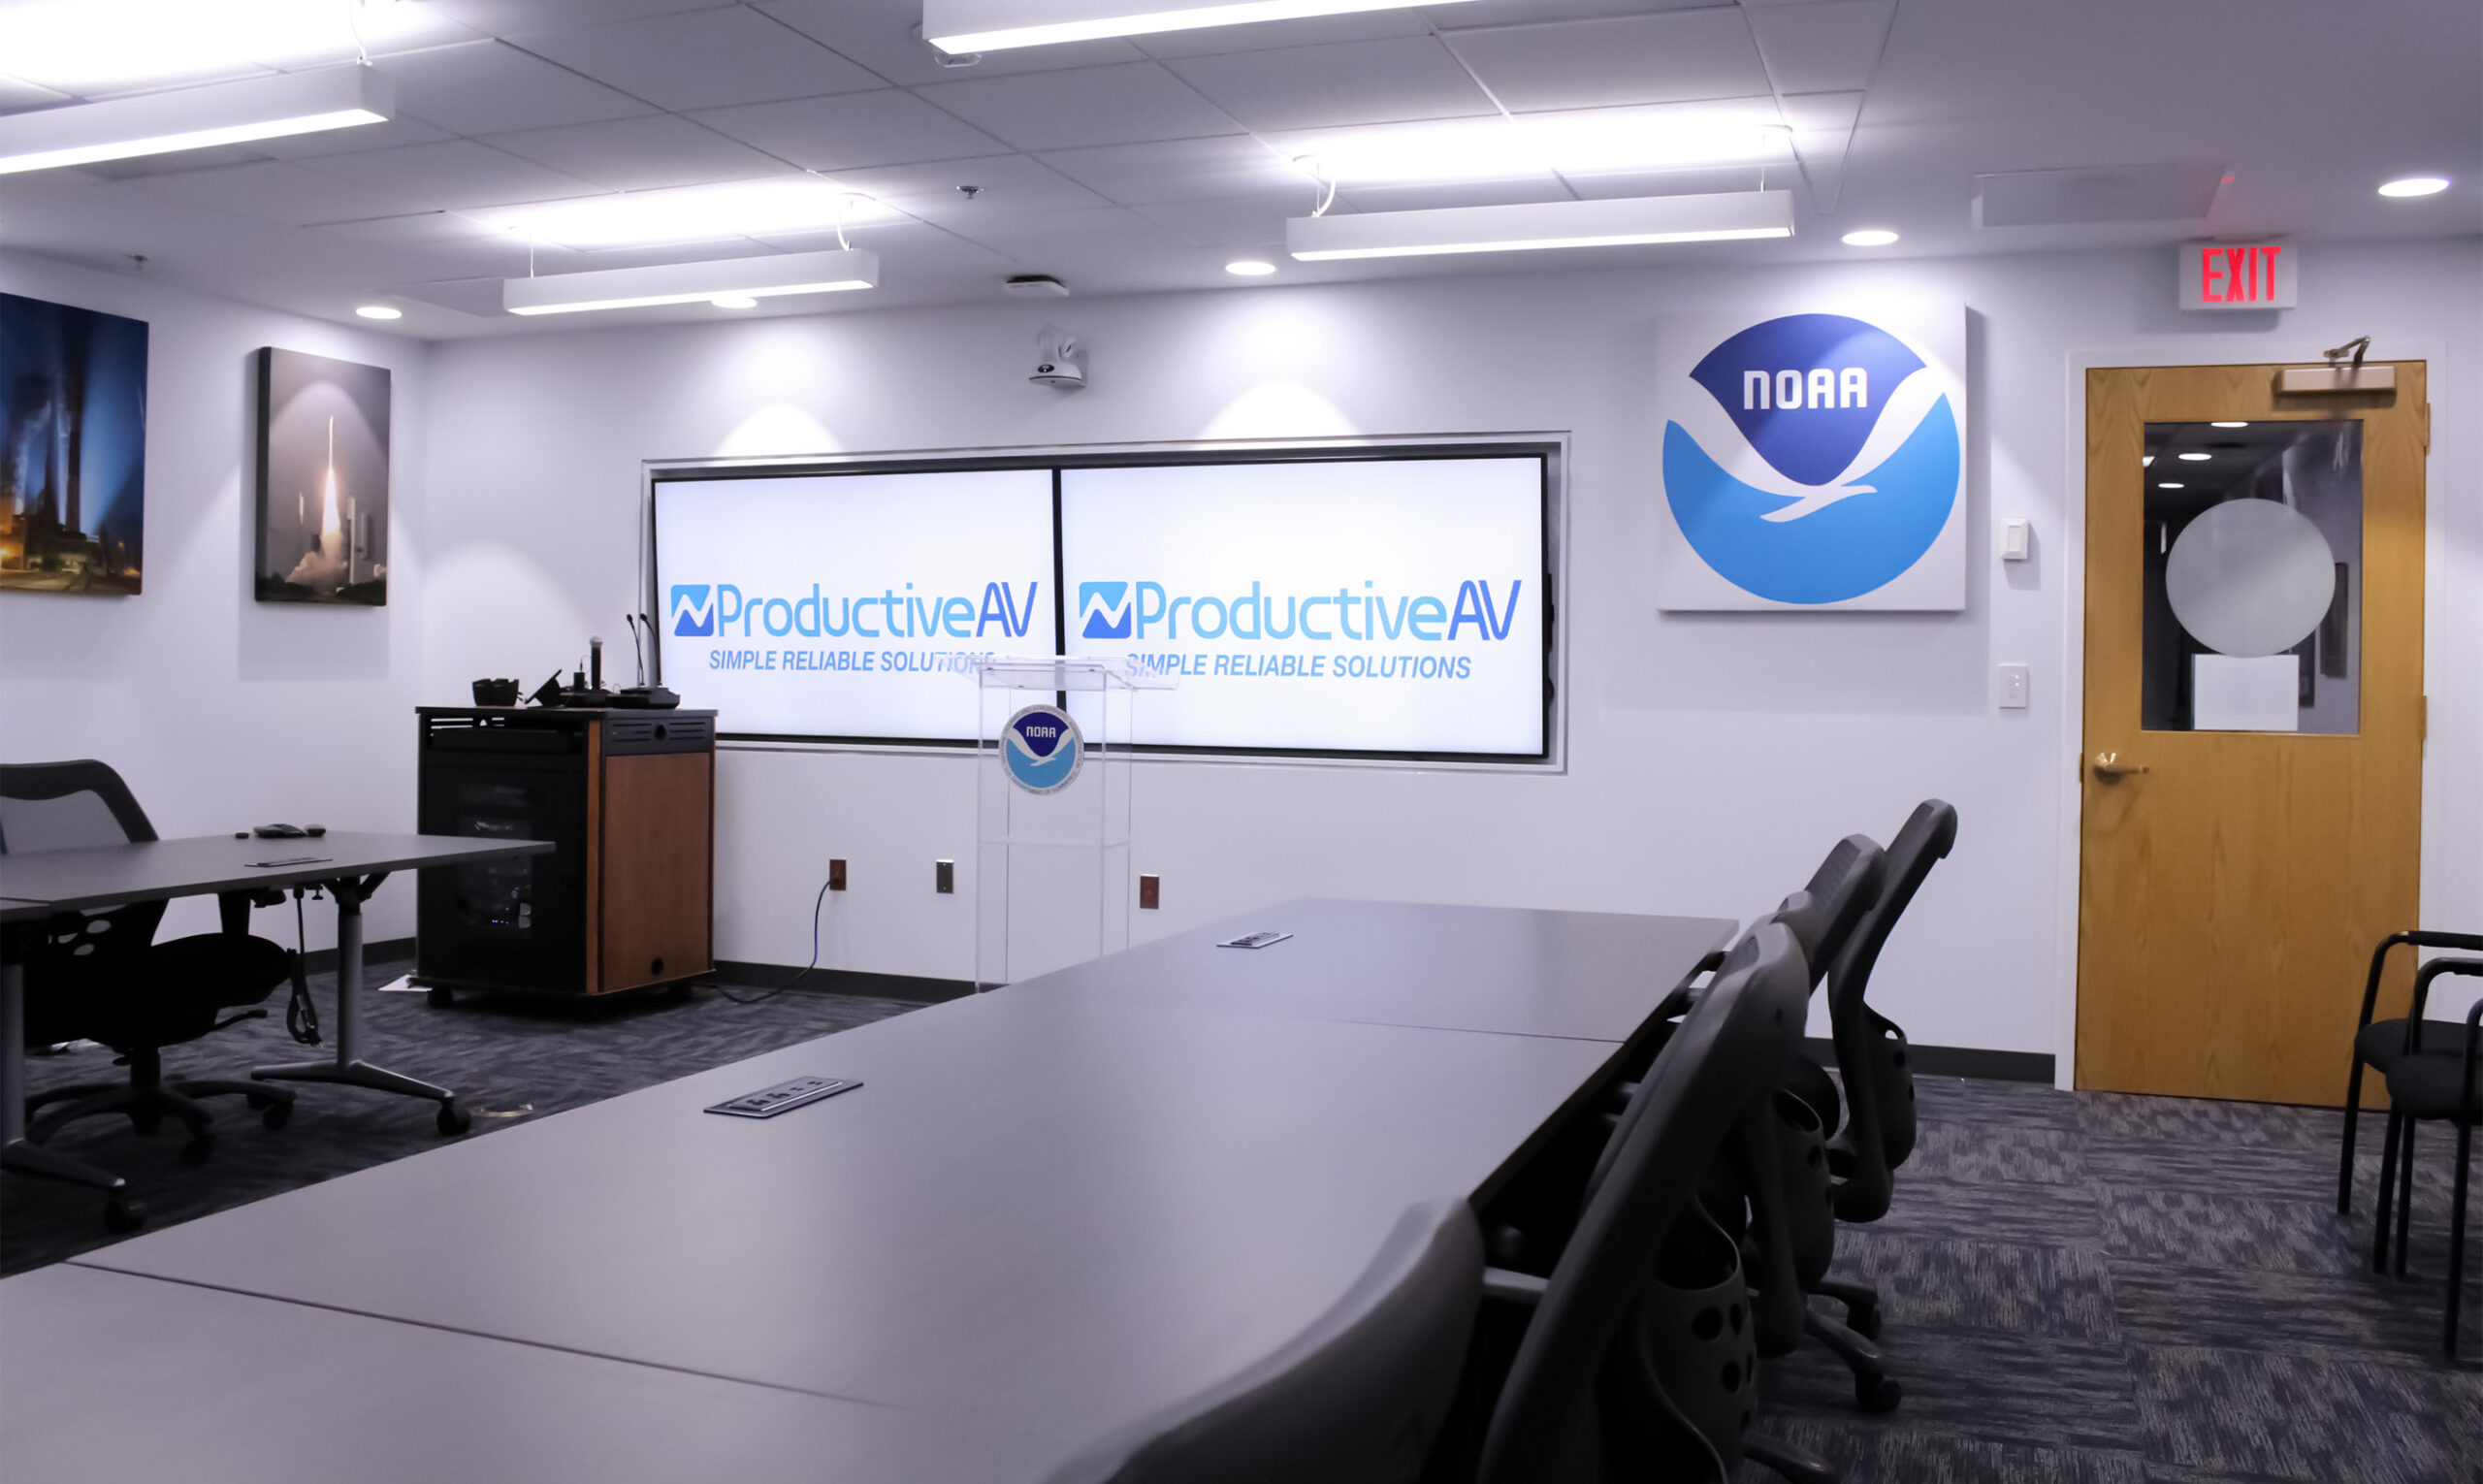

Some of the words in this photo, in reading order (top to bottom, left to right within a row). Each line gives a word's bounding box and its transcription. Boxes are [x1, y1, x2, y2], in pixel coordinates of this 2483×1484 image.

[2202, 246, 2281, 303] EXIT
[1744, 367, 1868, 410] NOAA
[717, 581, 1039, 638] ProductiveAV
[1136, 579, 1523, 641] ProductiveAV
[709, 650, 777, 671] SIMPLE
[782, 651, 875, 672] RELIABLE
[1213, 655, 1326, 677] RELIABLE
[1333, 656, 1472, 680] SOLUTIONS
[1026, 726, 1056, 738] NOAA
